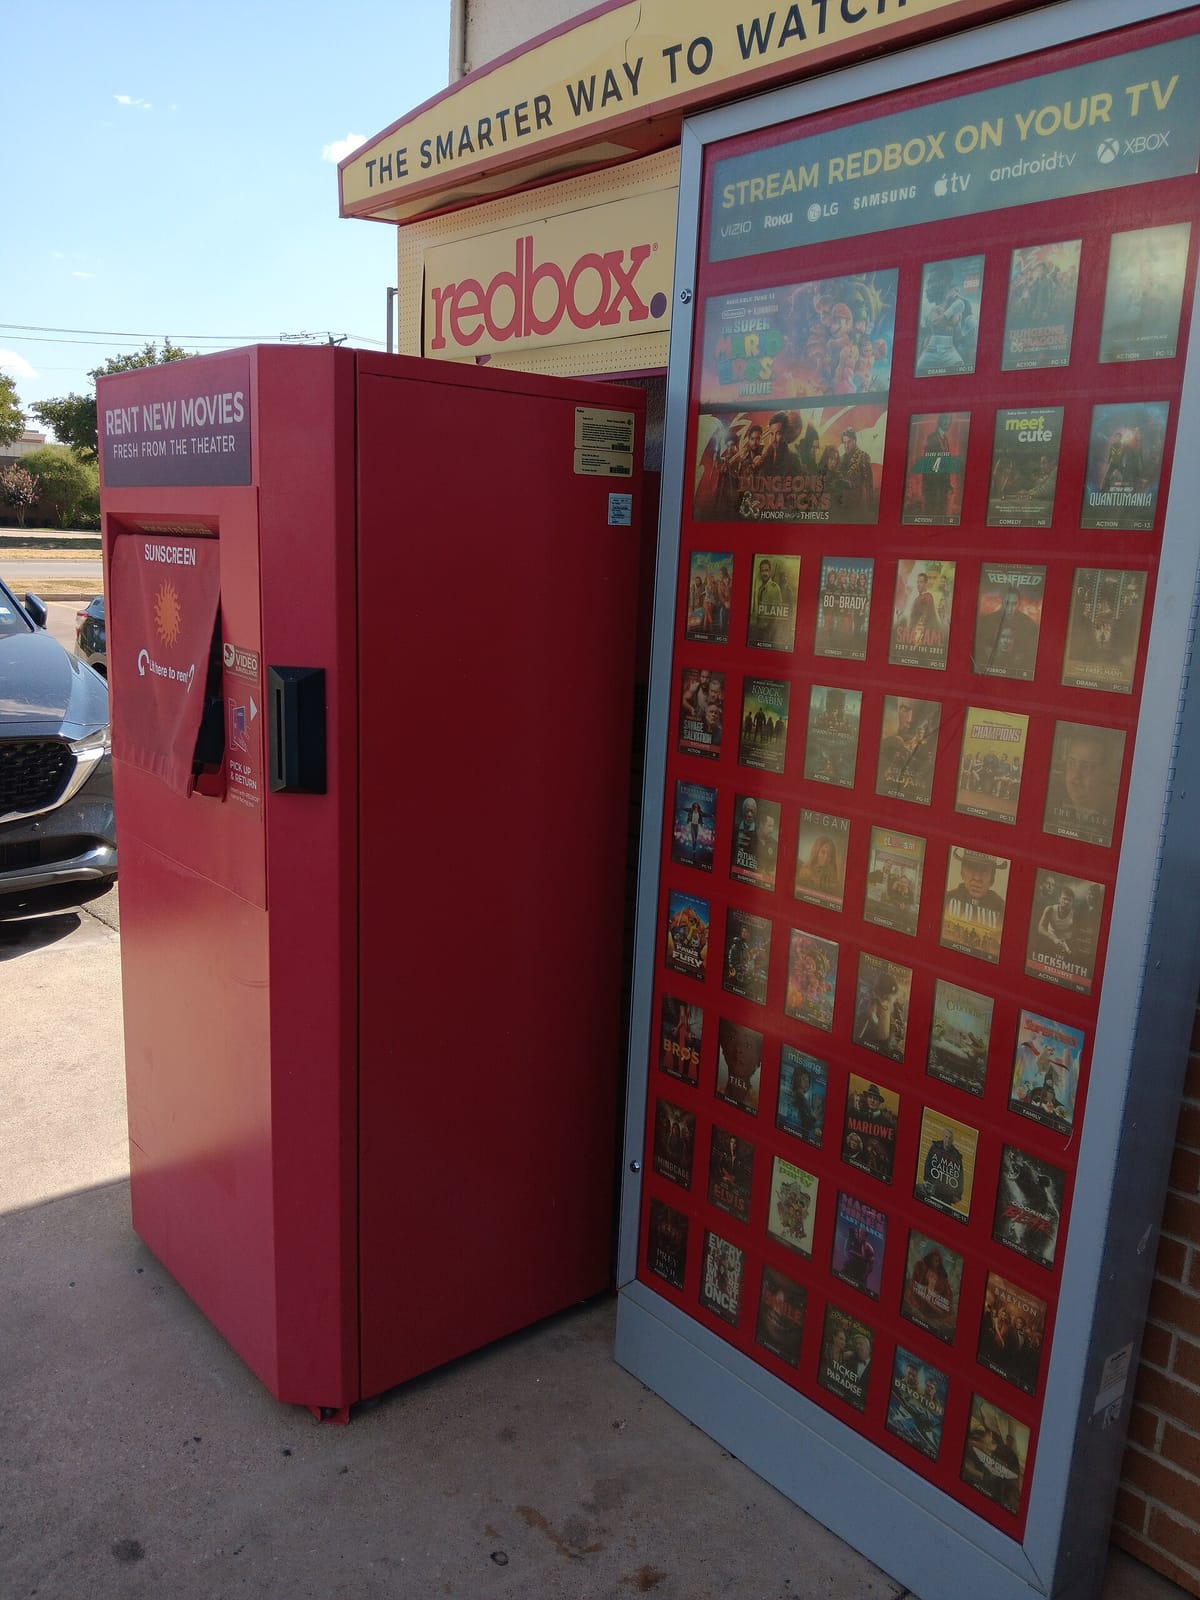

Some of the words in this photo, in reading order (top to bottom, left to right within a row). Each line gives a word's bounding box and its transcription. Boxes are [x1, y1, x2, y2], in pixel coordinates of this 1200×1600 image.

[365, 147, 409, 188] THE
[420, 93, 553, 169] SMARTER
[566, 57, 644, 118] WAY
[661, 36, 713, 84] TO
[722, 163, 820, 209] STREAM
[828, 131, 946, 186] REDBOX
[955, 118, 1003, 154] ON
[1015, 92, 1113, 140] YOUR
[1125, 74, 1179, 117] TV
[721, 220, 752, 238] VIZIO
[853, 185, 917, 210] SAMSUNG
[950, 172, 971, 193] tv
[1122, 130, 1171, 156] XBOX
[1008, 324, 1065, 339] DUNGEONS
[1016, 360, 1037, 368] ACTION
[1116, 352, 1140, 360] ACTION
[739, 382, 773, 396] MOVIE
[105, 406, 140, 436] RENT
[143, 400, 177, 432] NEW
[181, 391, 245, 428] MOVIES
[1005, 415, 1045, 431] meet
[1018, 428, 1053, 443] cute
[113, 444, 138, 459] FRESH
[141, 439, 167, 457] FROM
[170, 439, 187, 455] THE
[191, 434, 236, 454] THEATER
[737, 475, 825, 493] DUNGEONS
[1089, 492, 1151, 508] QUANTUMANIA
[760, 511, 785, 520] HONOR
[801, 511, 830, 520] THIEVES
[1133, 521, 1151, 529] PG-13
[144, 543, 196, 566] SUNSCREEN
[987, 572, 1042, 588] RENFIELD
[823, 594, 834, 608] 80
[839, 596, 867, 610] BRADY
[758, 605, 790, 617] PLANE
[235, 653, 258, 671] VIDEO
[168, 666, 176, 679] to
[751, 684, 781, 698] KNOCK
[1076, 679, 1098, 688] DRAMA
[757, 694, 783, 706] CABIN
[971, 724, 1022, 744] CHAMPIONS
[230, 760, 243, 773] PICK
[243, 764, 252, 775] UP
[235, 773, 257, 790] RETURN
[966, 806, 988, 816] COMEDY
[1057, 828, 1079, 838] DRAMA
[736, 857, 758, 870] KILLER
[949, 897, 973, 922] OLD
[976, 905, 998, 929] WAY
[952, 943, 971, 953] ACTION
[672, 949, 703, 969] FURY
[1032, 951, 1088, 977] LOCKSMITH
[1038, 972, 1059, 983] ACTION
[663, 1038, 700, 1065] BROS
[788, 1052, 822, 1075] missing
[939, 1073, 957, 1084] FAMILY
[1022, 1108, 1042, 1121] FAMILY
[847, 1116, 894, 1140] MARLOWE
[931, 1153, 938, 1161] A
[940, 1156, 961, 1171] MAN
[931, 1159, 960, 1179] CALLED
[779, 1166, 814, 1189] PARTY
[930, 1168, 959, 1189] OTTO
[713, 1183, 745, 1211] ELVIS
[1011, 1200, 1051, 1221] COCAINE
[1002, 1238, 1029, 1254] SUSPENSE
[704, 1283, 738, 1315] ONCE
[993, 1286, 1038, 1317] BABYLON
[911, 1315, 929, 1329] DRAMA
[832, 1359, 859, 1383] TICKET
[826, 1367, 863, 1398] PARADISE
[894, 1378, 945, 1417] DEVOTION
